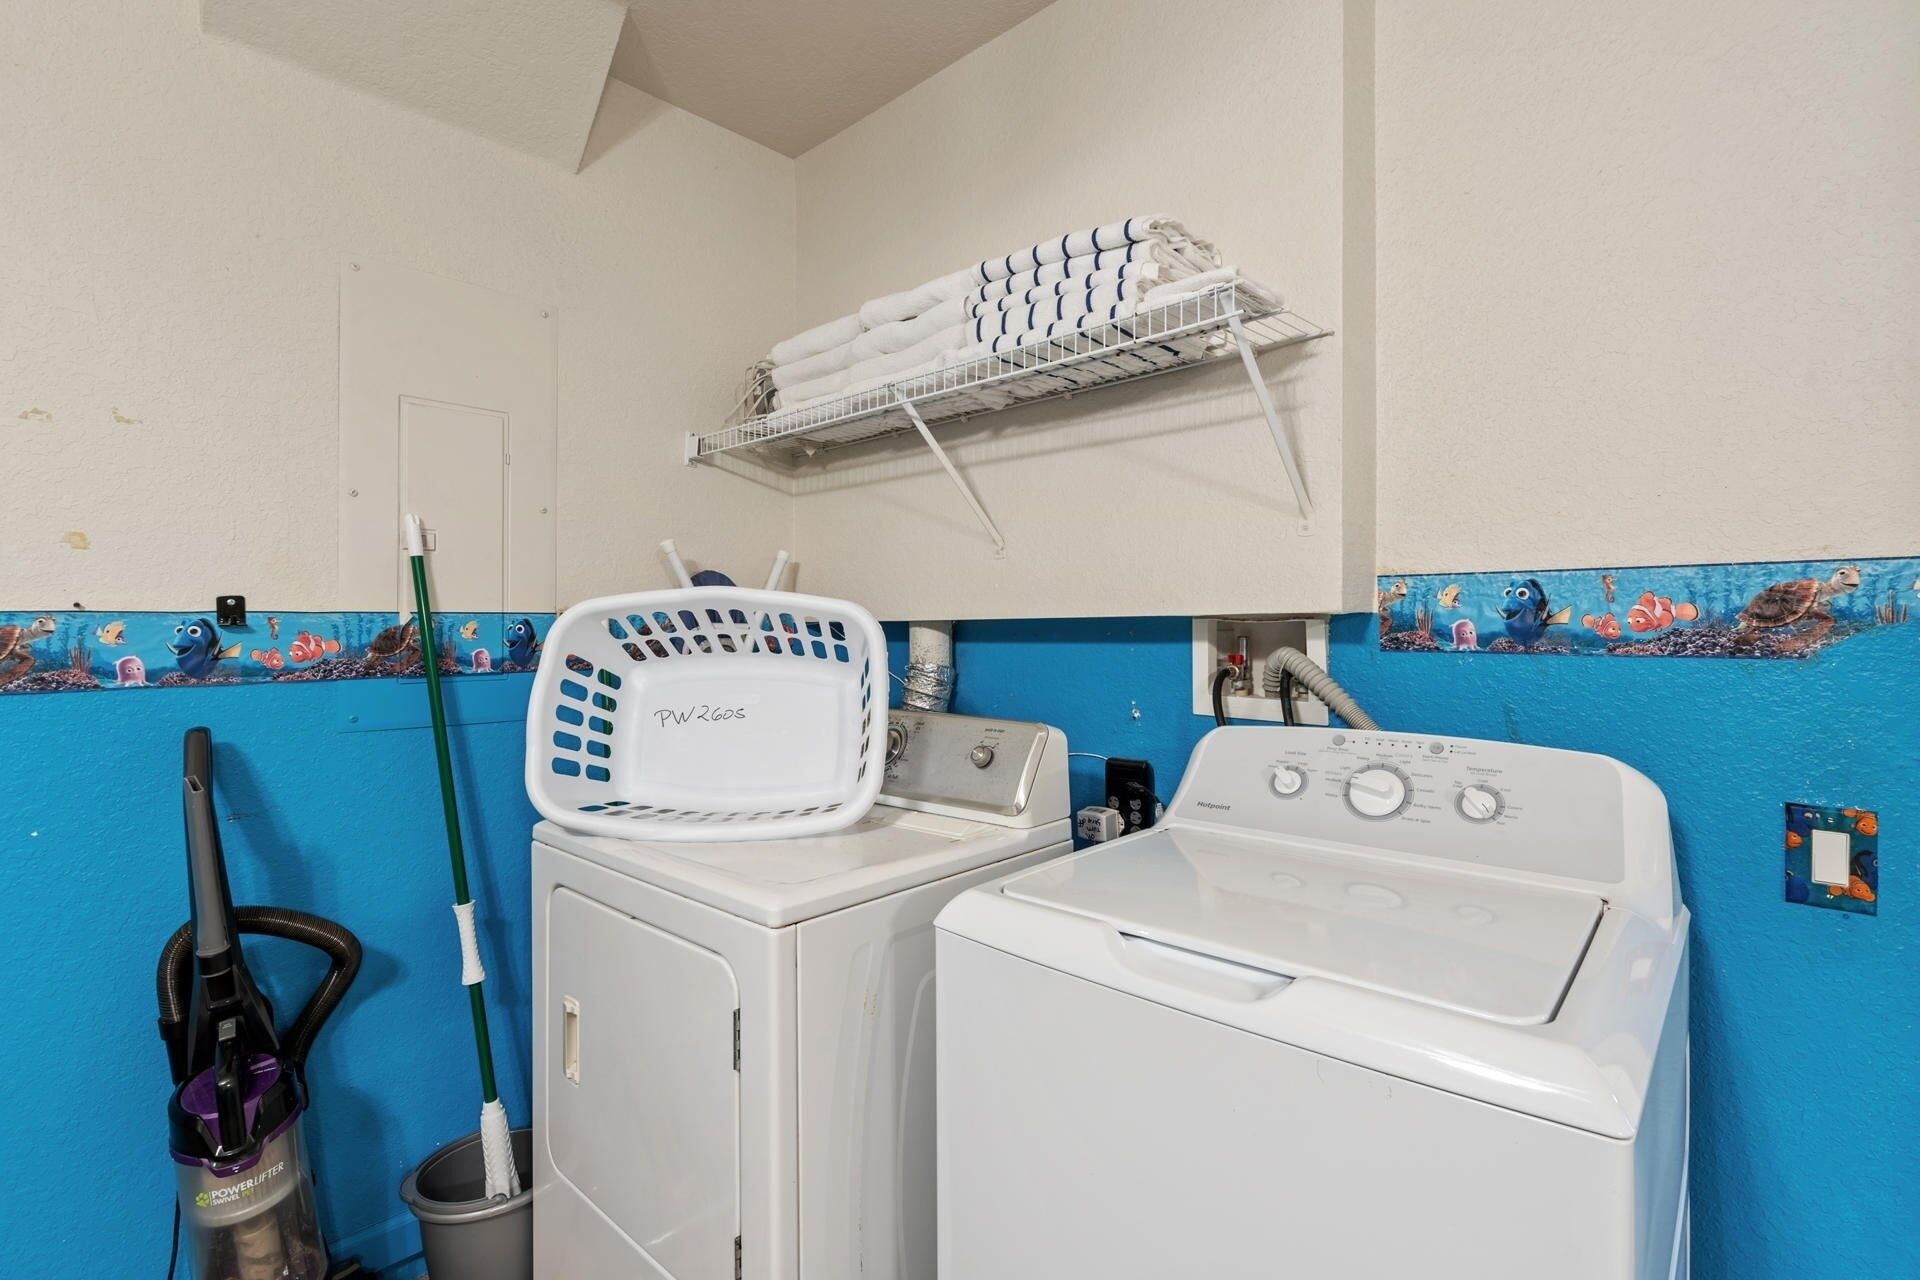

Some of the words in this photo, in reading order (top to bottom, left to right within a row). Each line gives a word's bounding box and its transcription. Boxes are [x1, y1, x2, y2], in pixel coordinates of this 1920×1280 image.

[1197, 801, 1231, 810] Hotpoint
[211, 1161, 284, 1199] POWERLIFTER
[212, 1193, 241, 1206] SWIVEL
